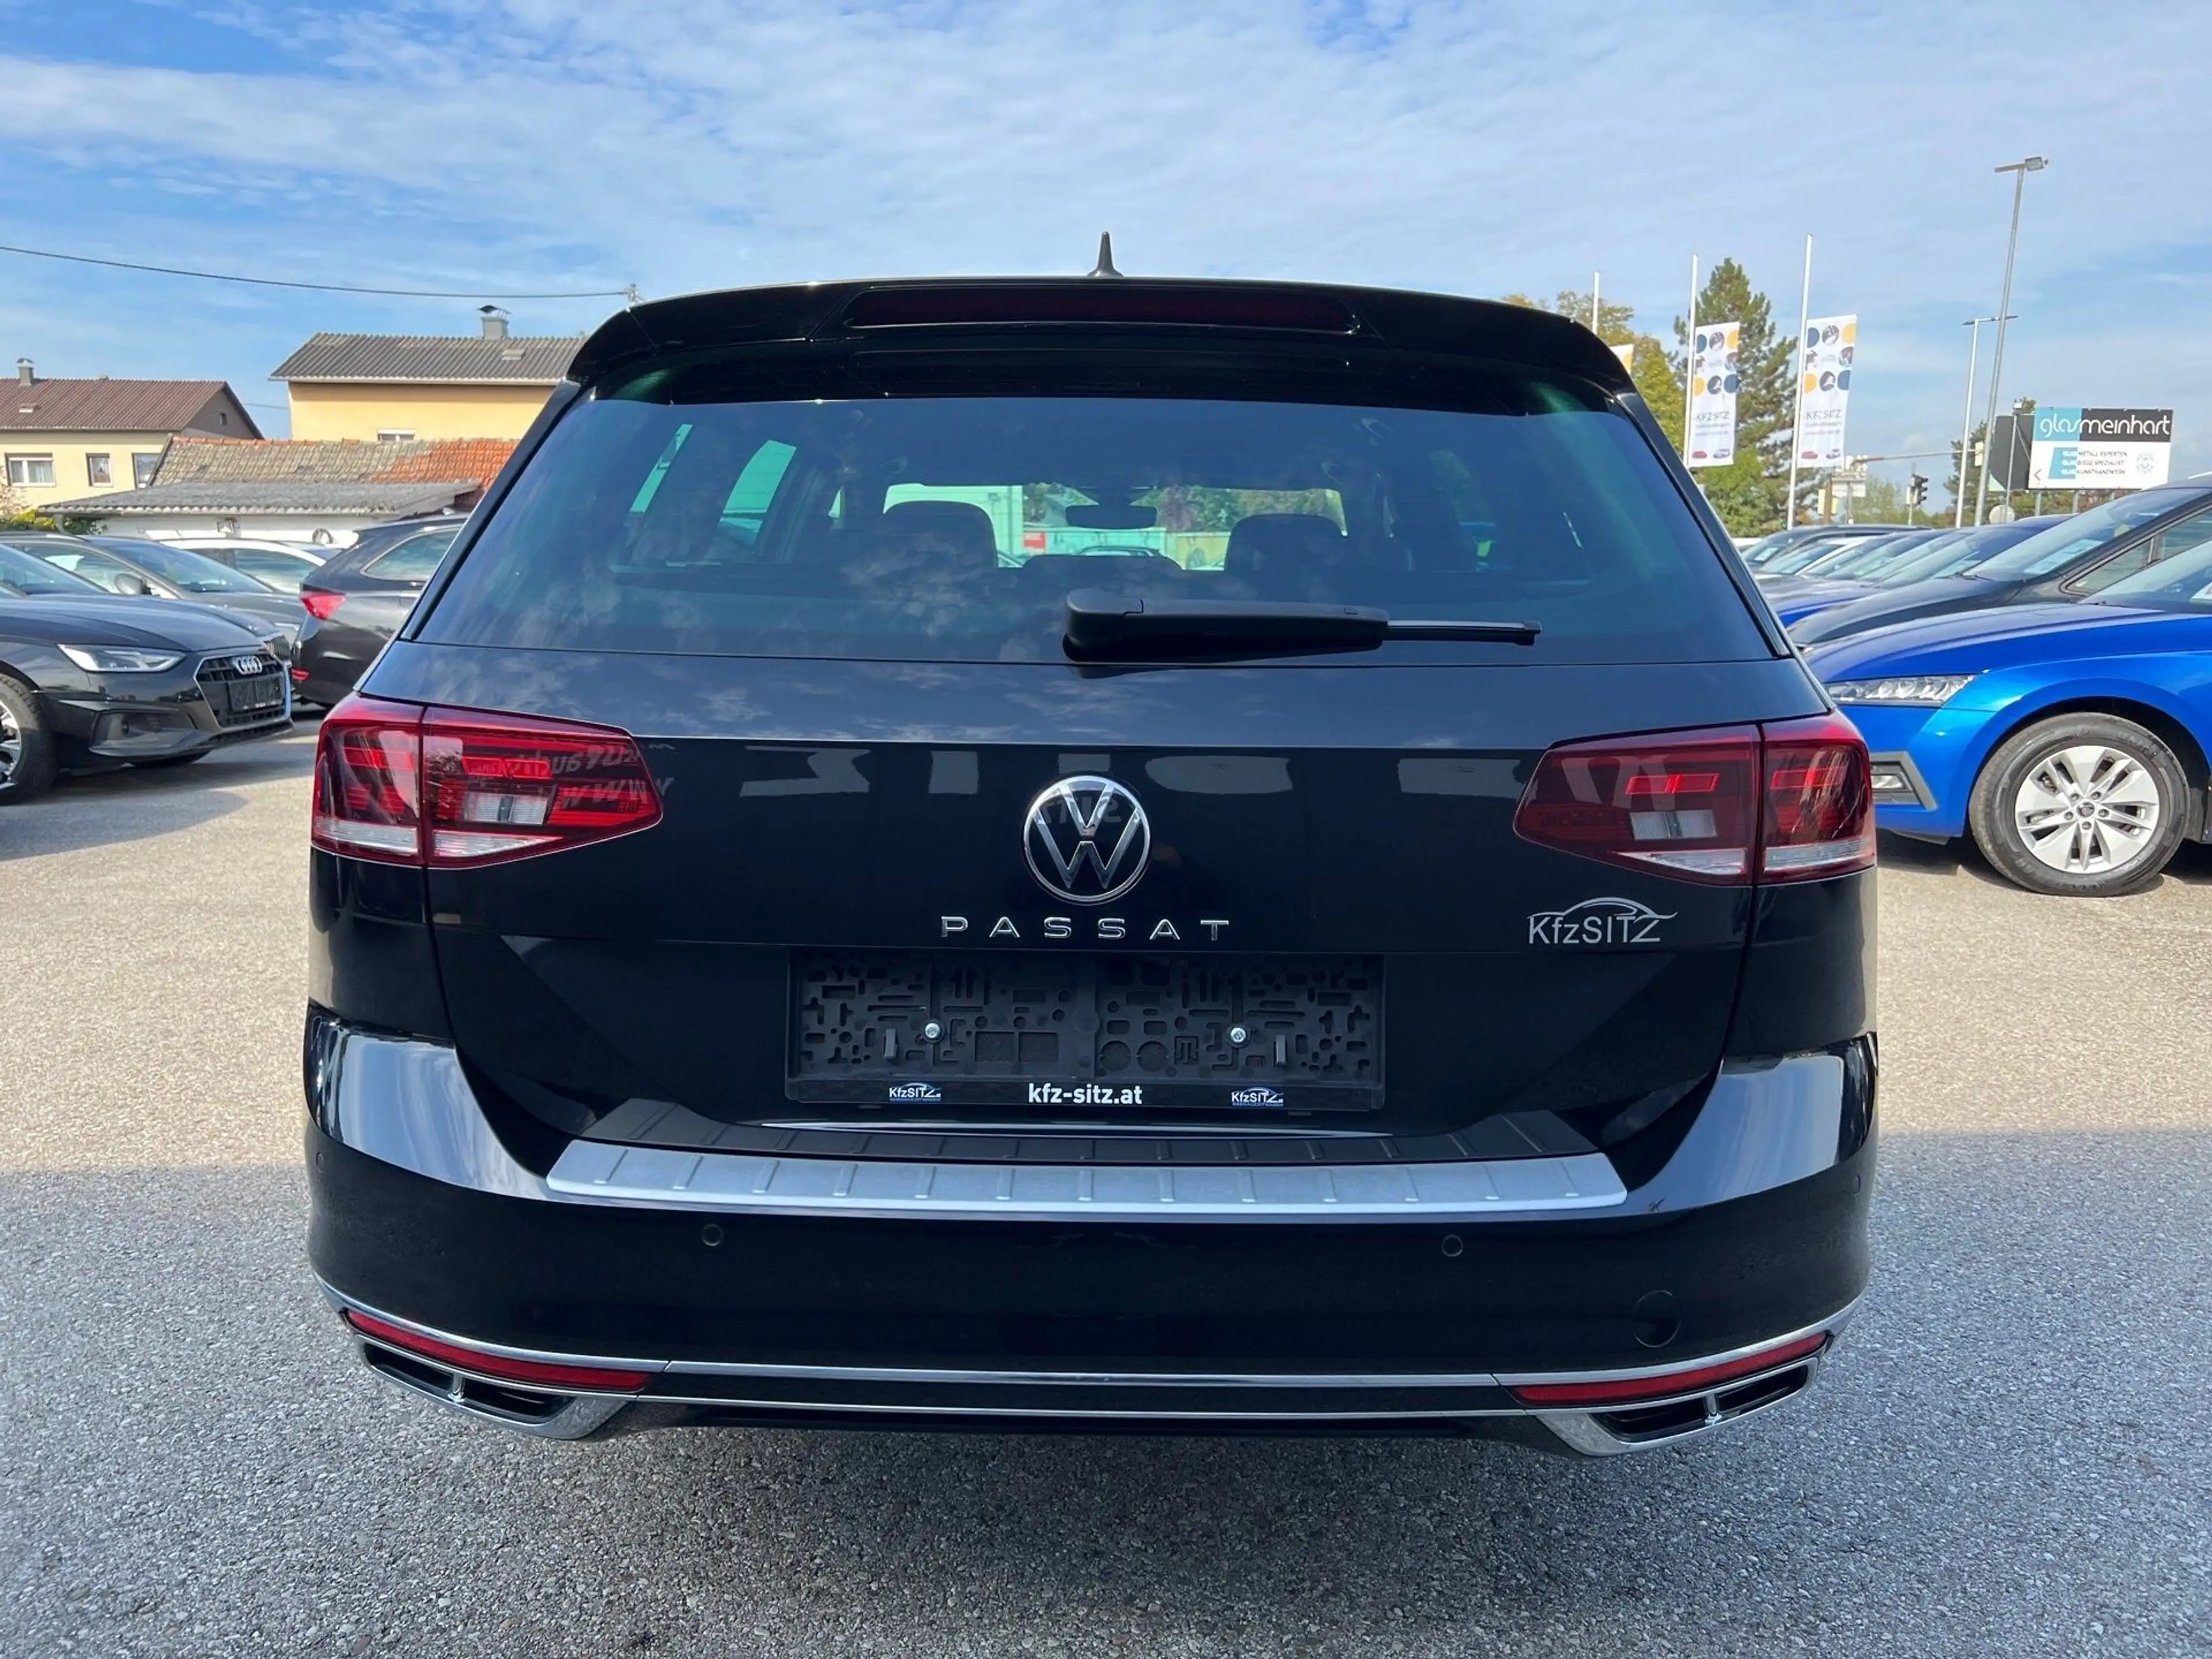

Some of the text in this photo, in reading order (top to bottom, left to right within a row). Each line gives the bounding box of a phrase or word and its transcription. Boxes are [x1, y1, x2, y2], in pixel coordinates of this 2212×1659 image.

[940, 915, 1230, 941] PASSAT
[1528, 915, 1661, 944] KfzSITZ
[1028, 1082, 1143, 1104] kfz-sitz.at
